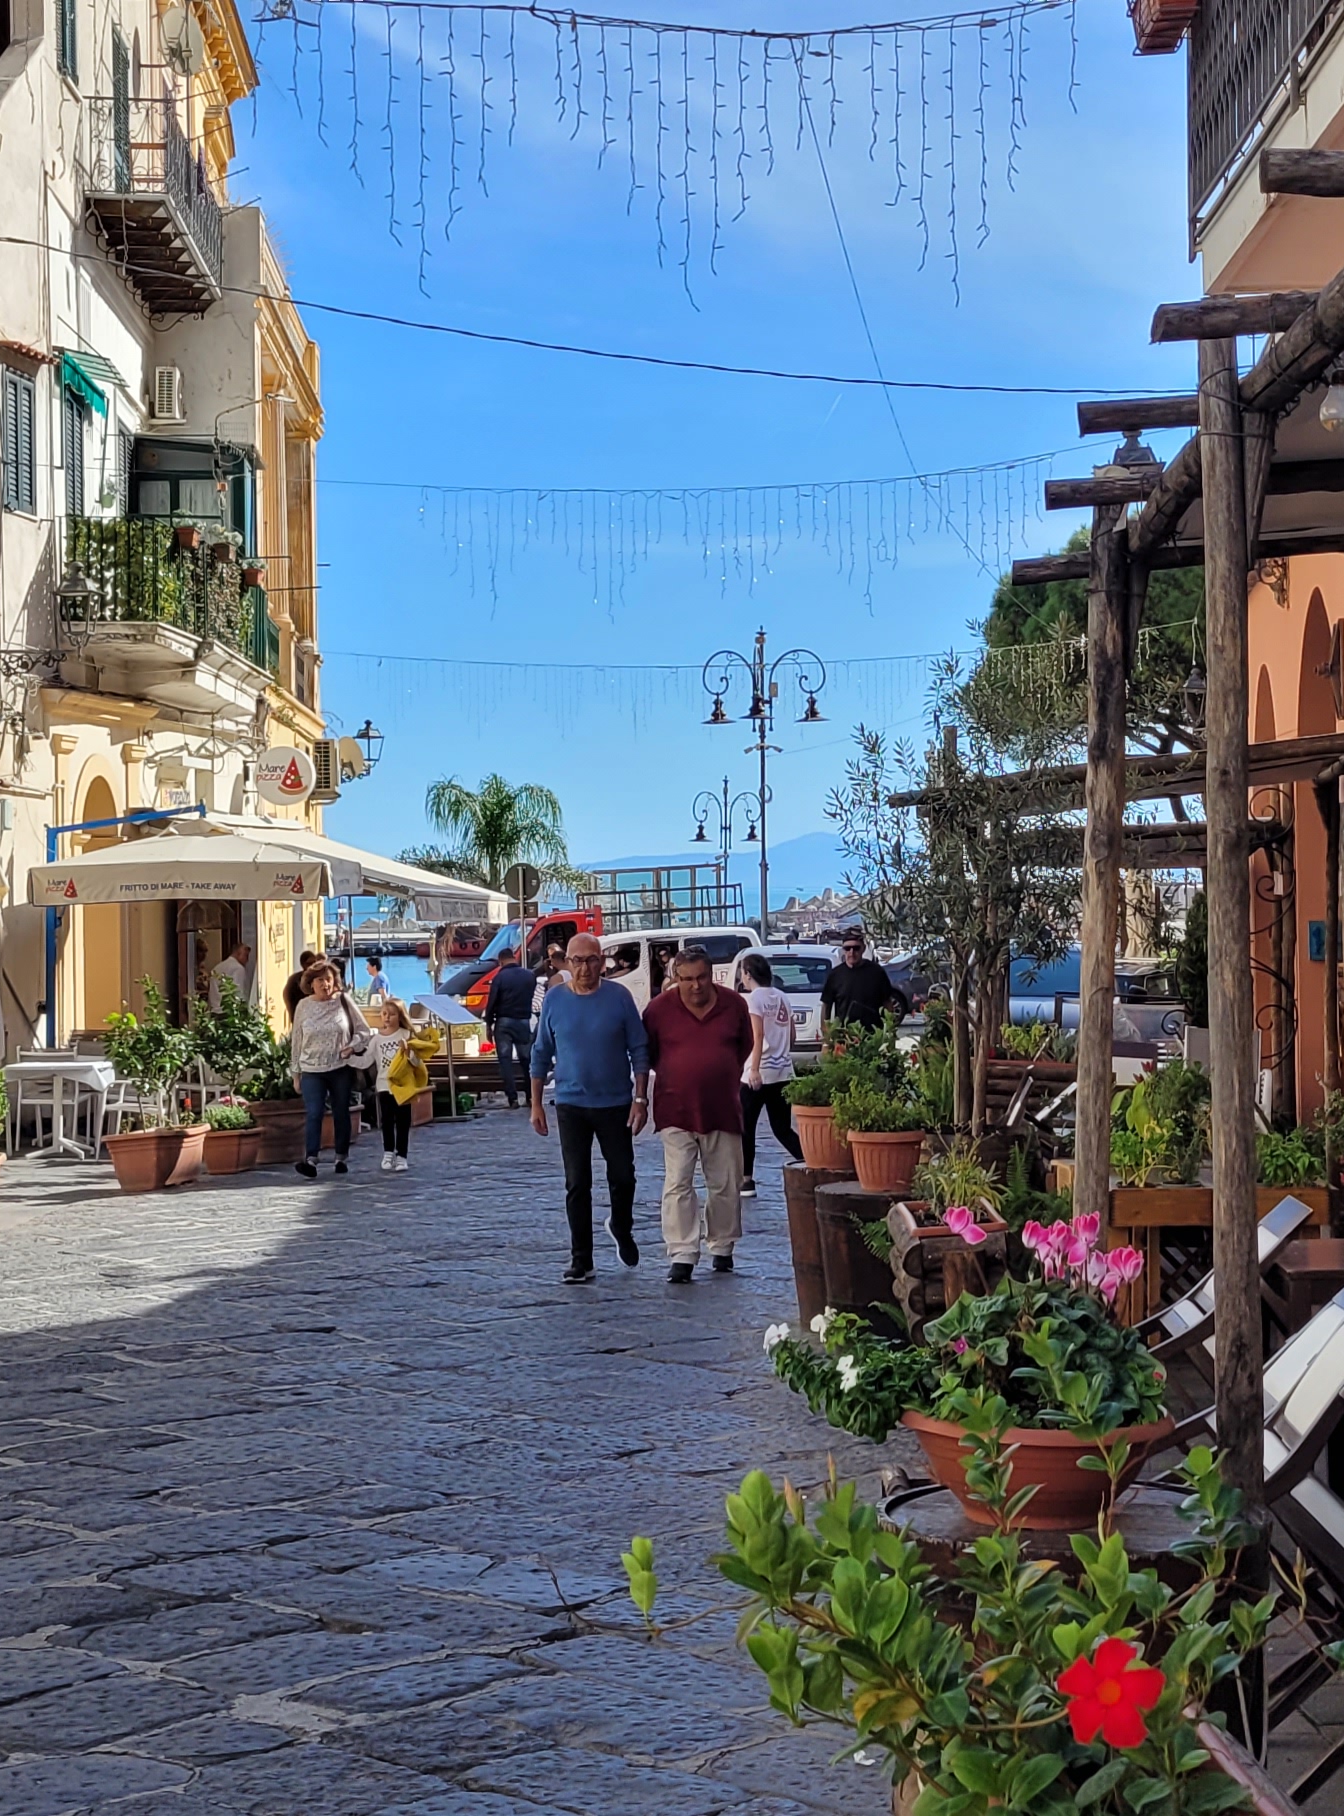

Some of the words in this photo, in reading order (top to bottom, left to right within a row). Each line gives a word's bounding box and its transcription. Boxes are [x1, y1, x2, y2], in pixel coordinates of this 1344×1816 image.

[259, 763, 286, 773] Mare
[120, 884, 149, 893] FRITTO
[150, 883, 159, 892] DI
[160, 882, 184, 890] MARE
[191, 882, 211, 890] TAKE
[213, 882, 236, 890] AWAY
